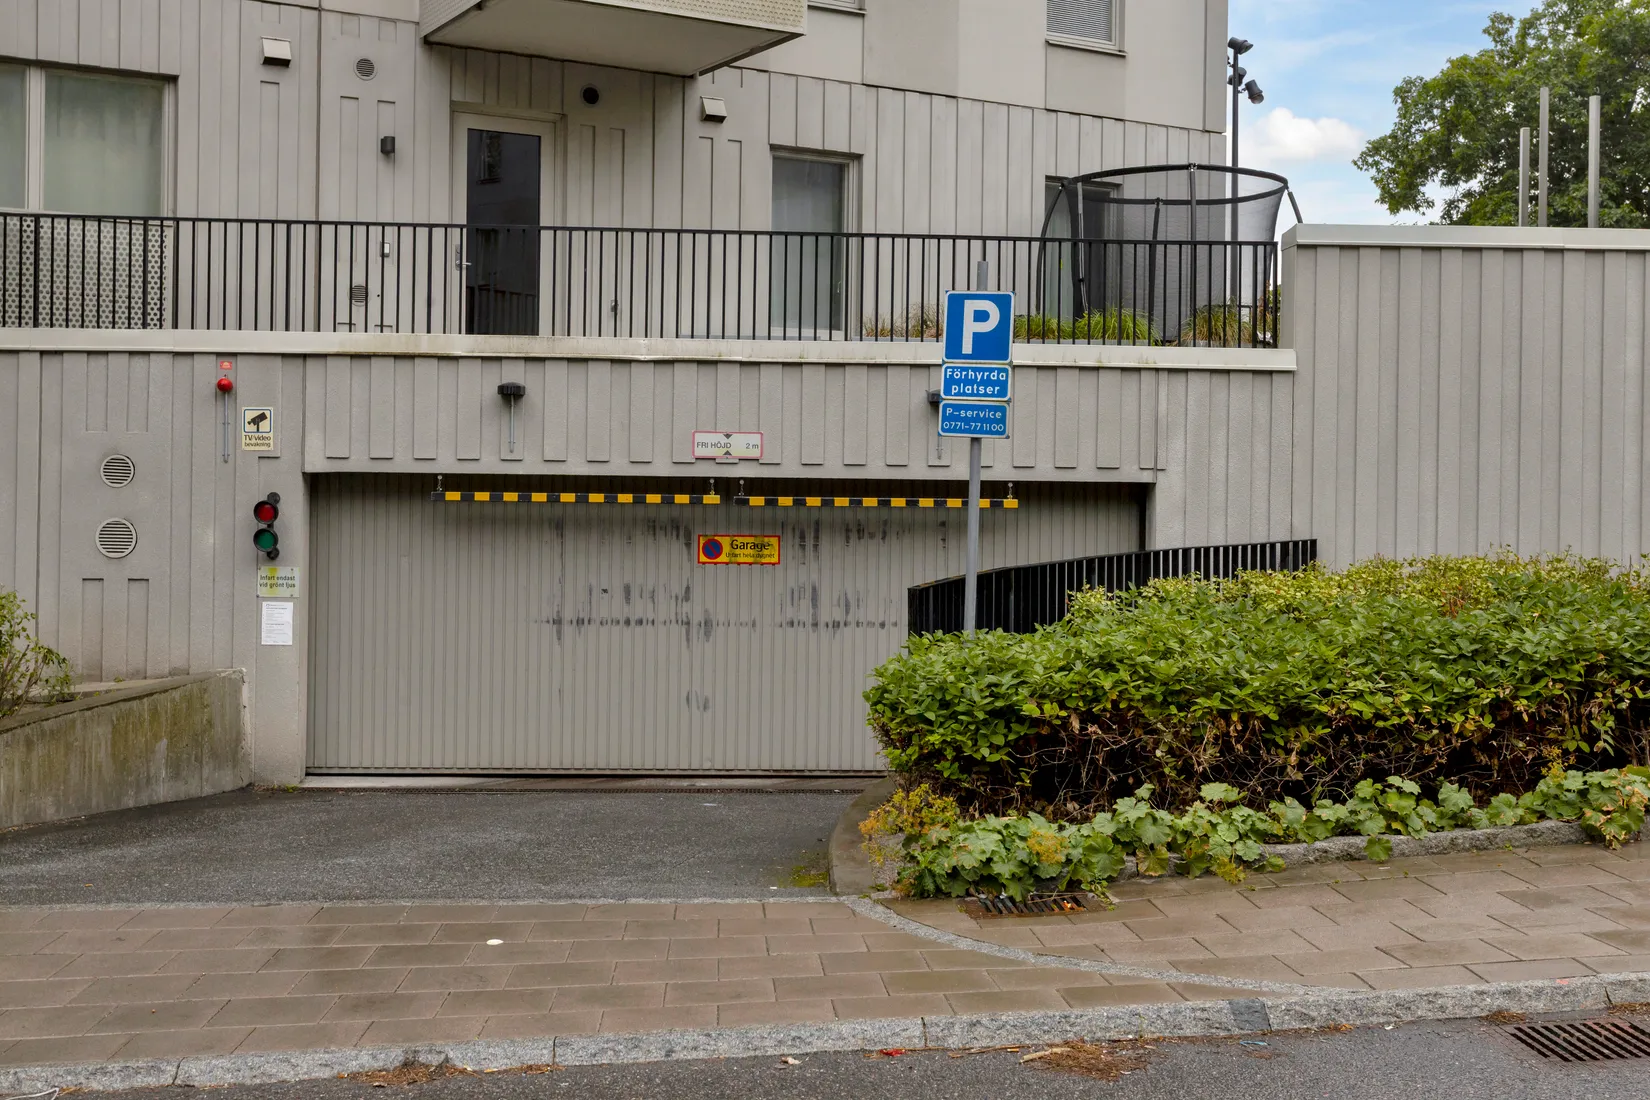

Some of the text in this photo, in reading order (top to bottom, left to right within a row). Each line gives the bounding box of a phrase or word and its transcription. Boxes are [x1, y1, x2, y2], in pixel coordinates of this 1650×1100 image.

[962, 299, 1000, 354] P
[946, 368, 1006, 382] Förhyrda
[951, 383, 1000, 395] platser
[946, 407, 1002, 418] P-service
[696, 441, 709, 449] FRI
[710, 440, 732, 449] HÖJD
[745, 442, 751, 450] 2
[730, 539, 770, 552] Garage
